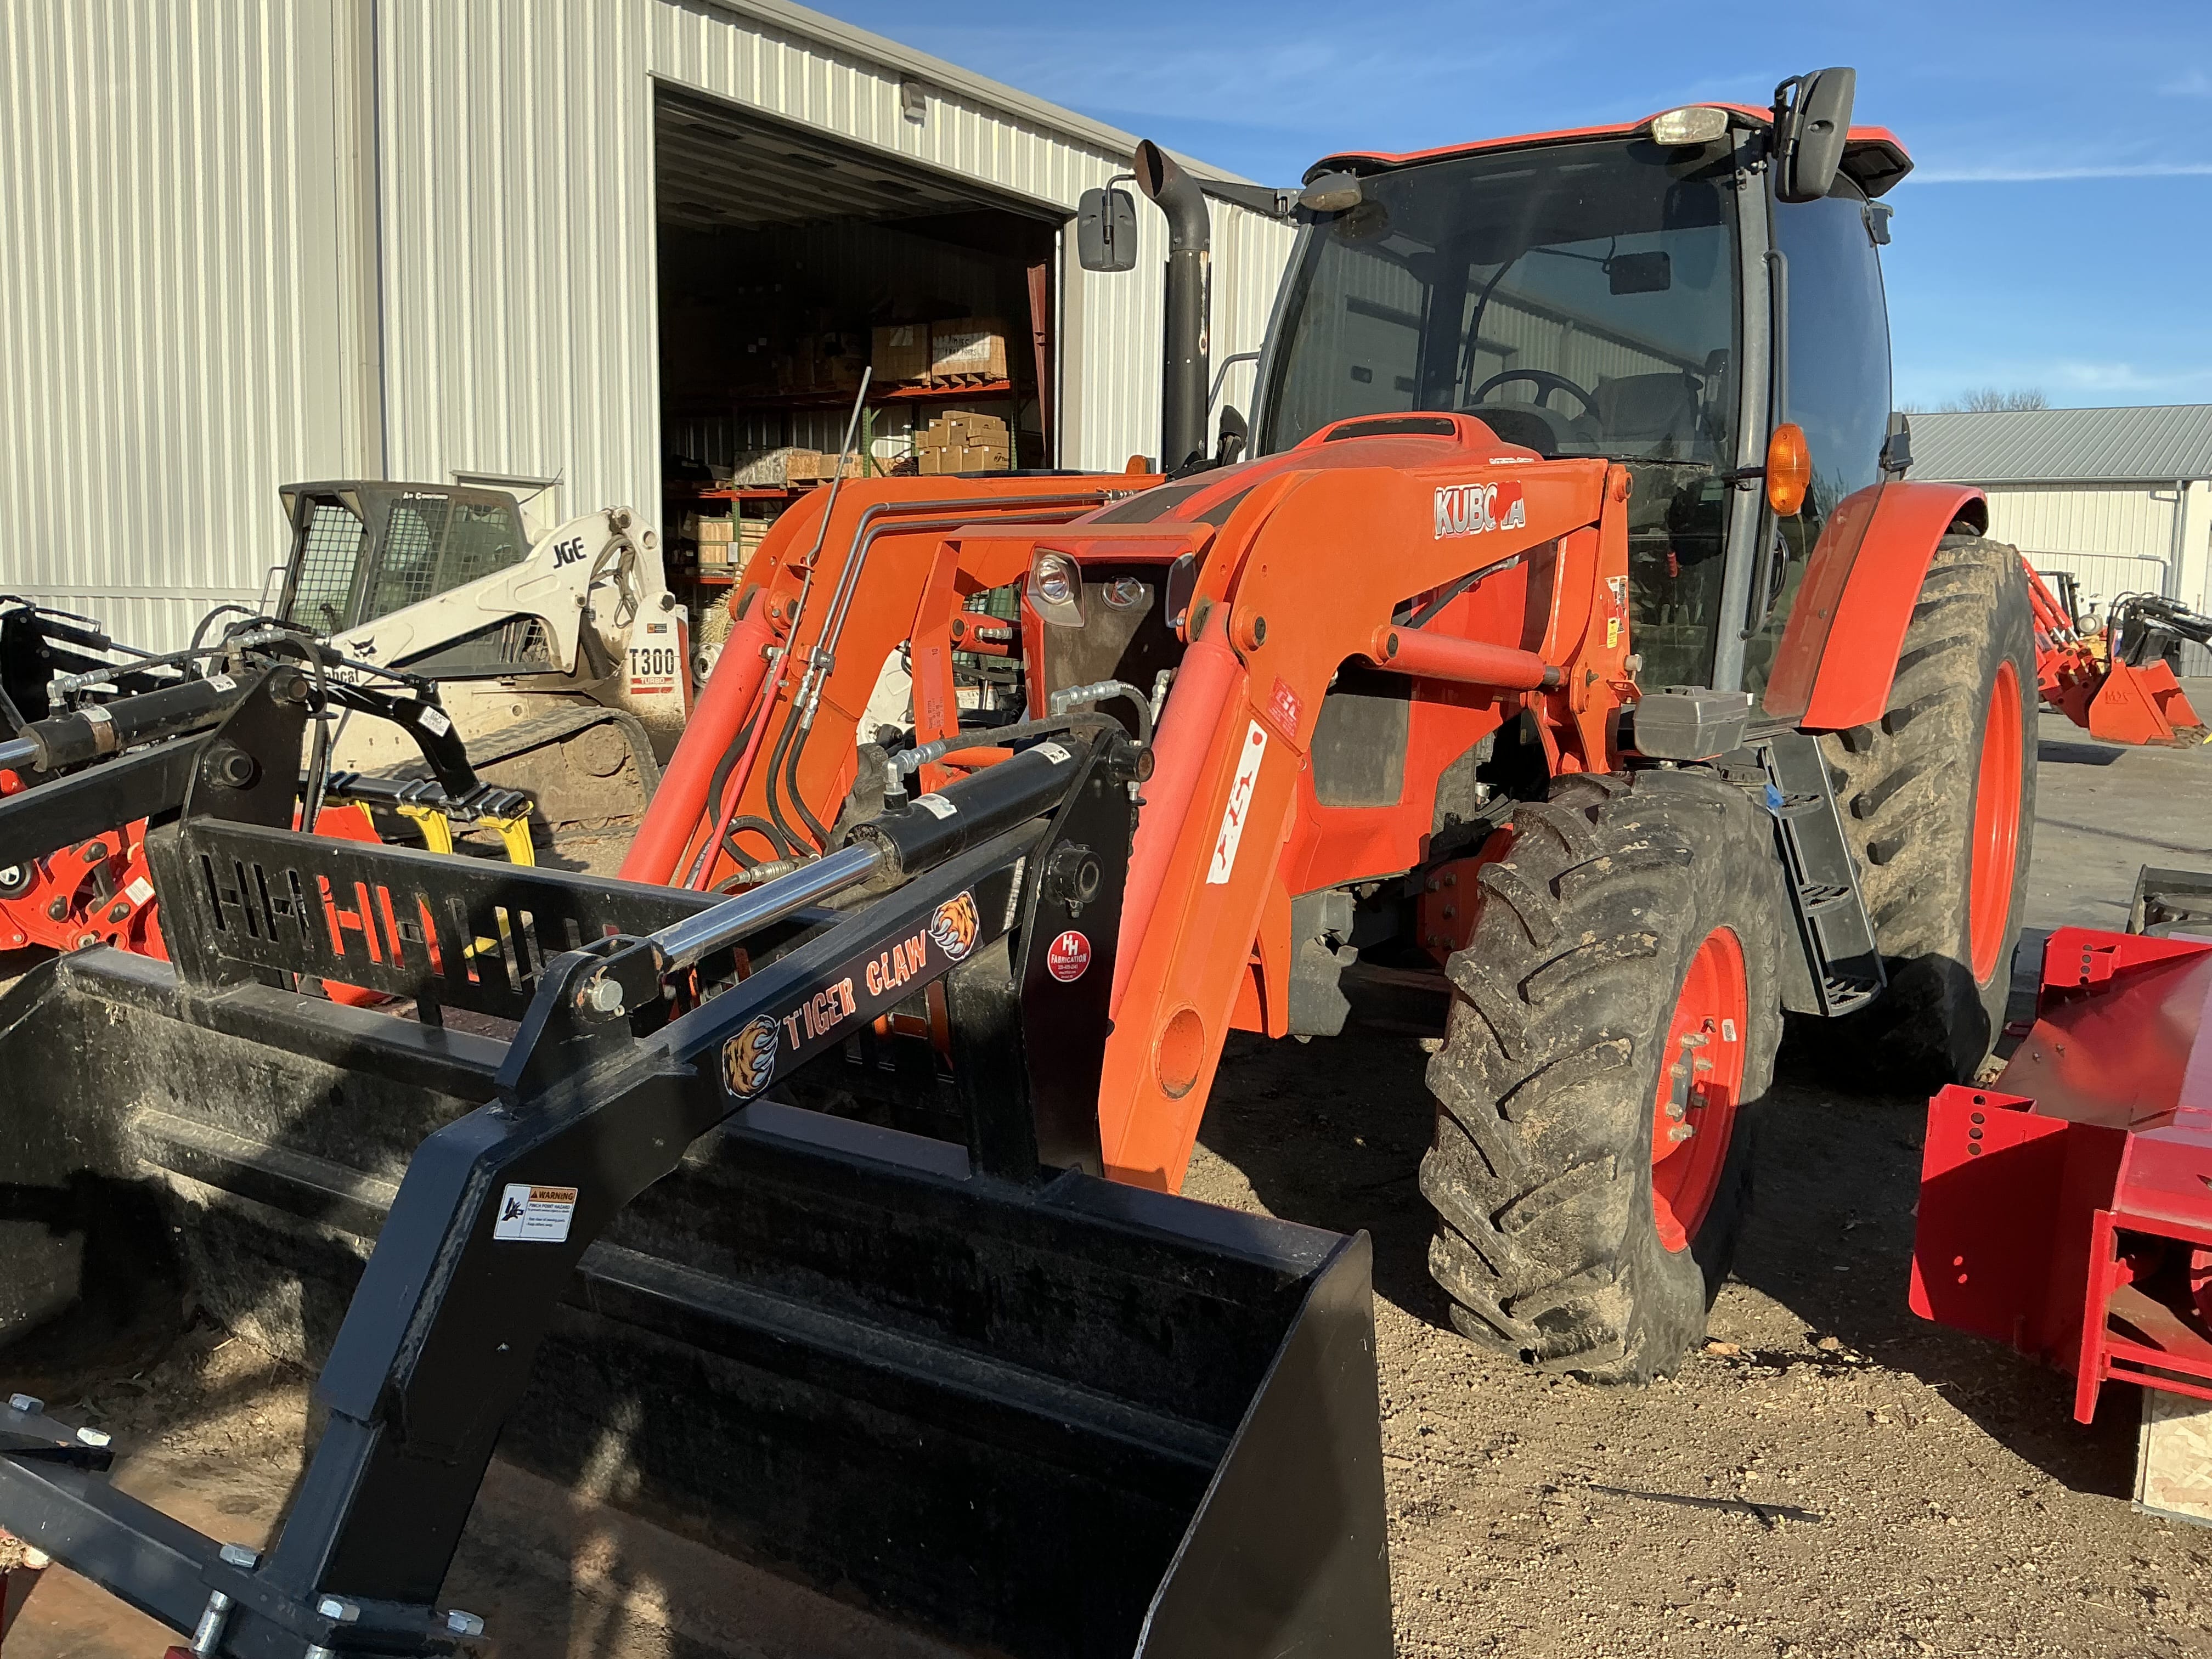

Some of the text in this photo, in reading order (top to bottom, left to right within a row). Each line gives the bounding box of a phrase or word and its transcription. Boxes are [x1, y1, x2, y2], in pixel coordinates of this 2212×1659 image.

[1435, 482, 1525, 539] KUBOA
[553, 536, 588, 569] JGE
[629, 648, 675, 675] T300
[1051, 953, 1087, 964] FABRICATION
[1062, 934, 1079, 956] HH
[783, 929, 927, 1051] TIGER CLAW
[538, 1190, 574, 1200] WARNING
